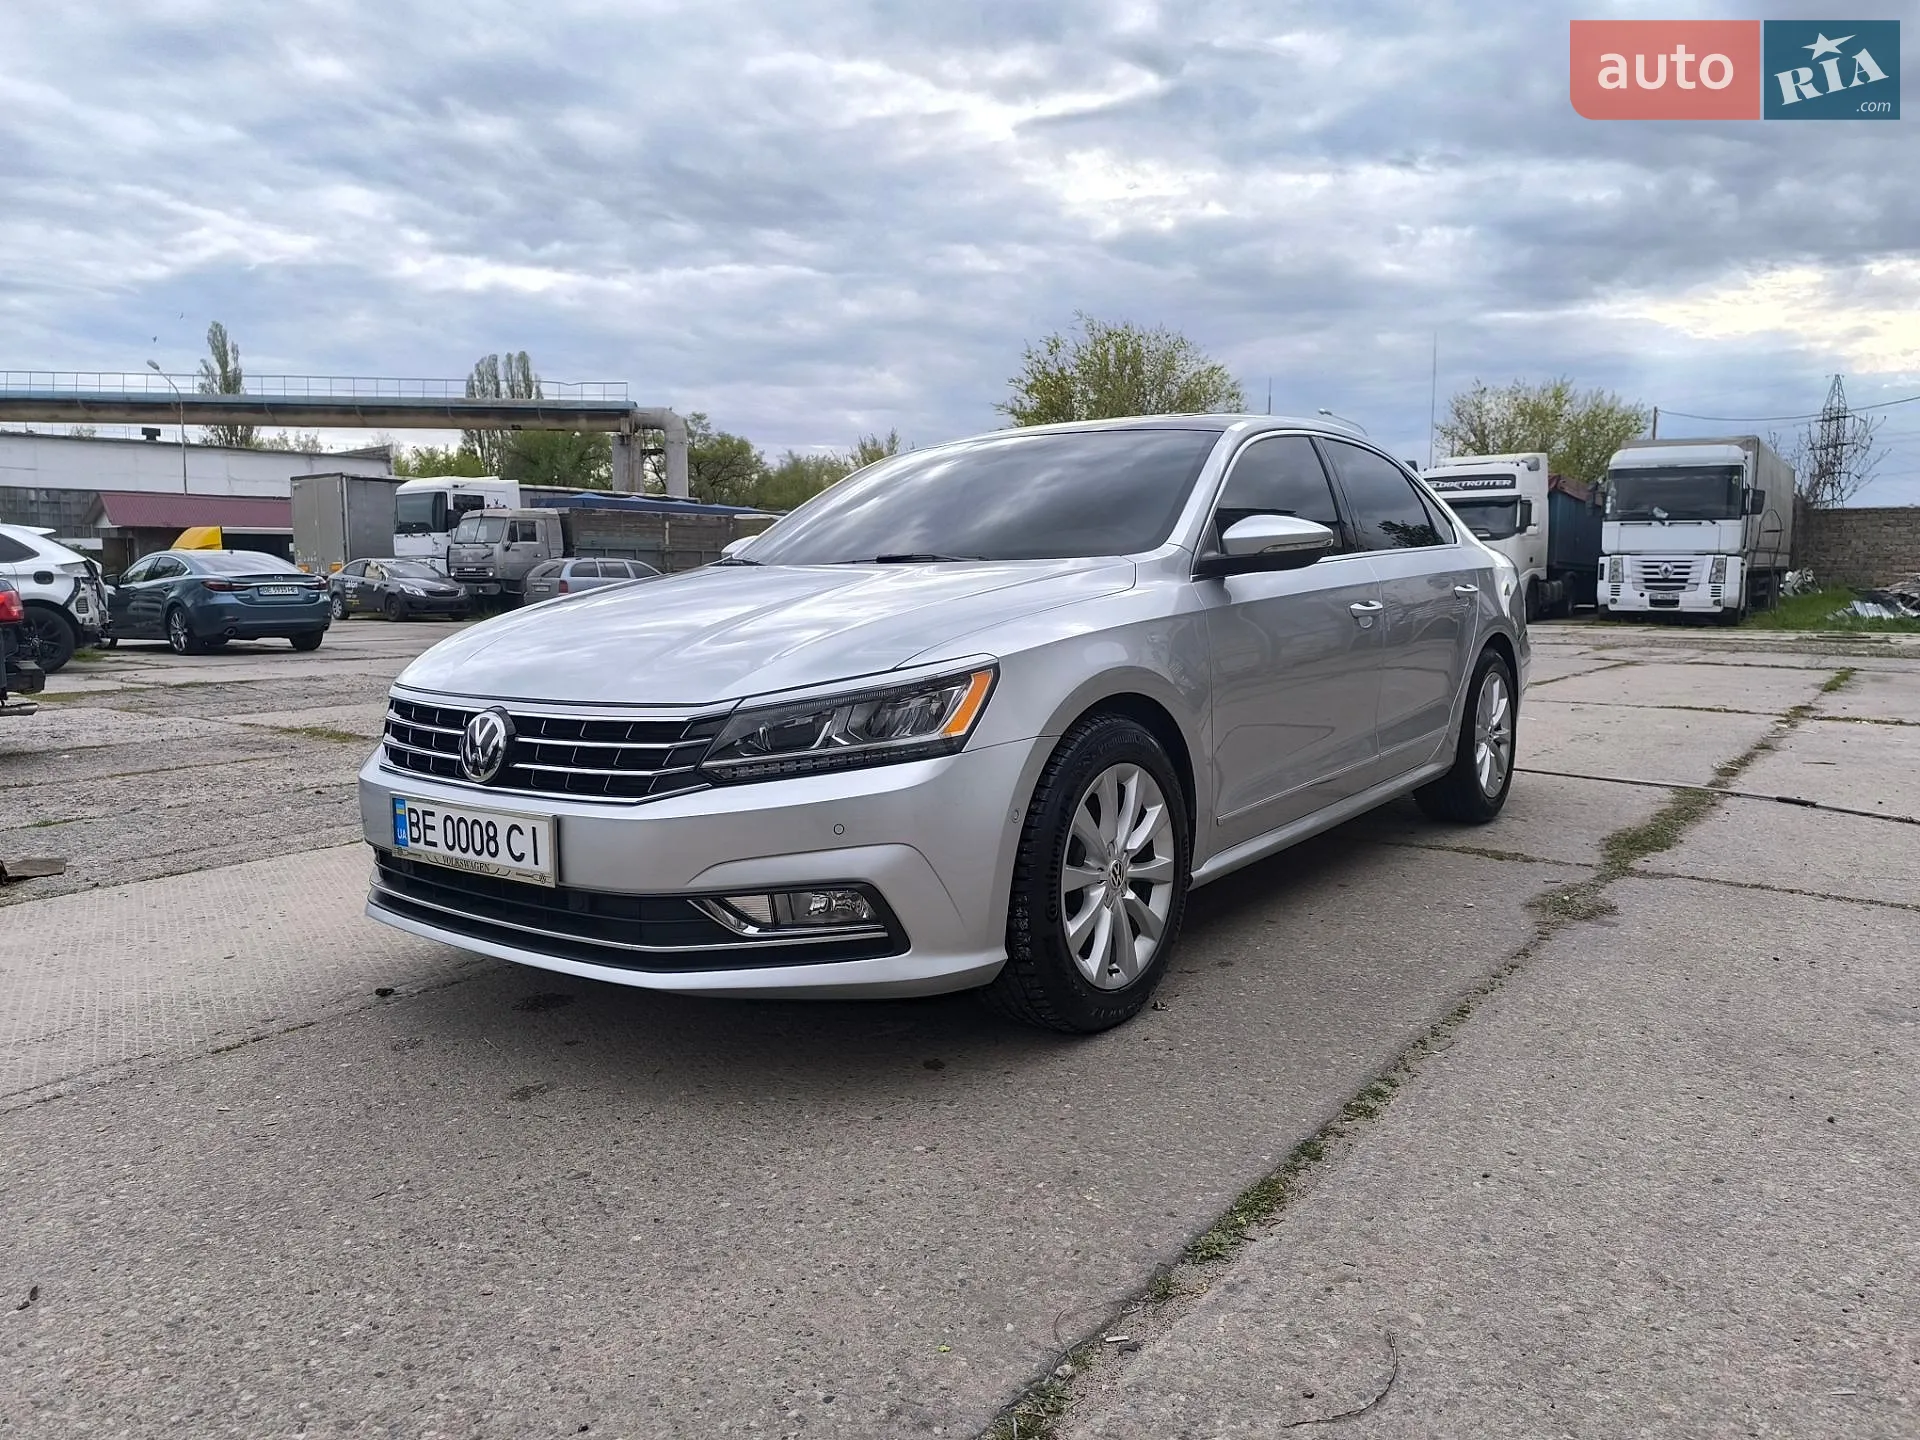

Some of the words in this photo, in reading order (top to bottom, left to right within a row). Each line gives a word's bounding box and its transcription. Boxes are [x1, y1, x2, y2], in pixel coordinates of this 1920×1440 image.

[397, 828, 408, 839] UA
[408, 807, 438, 848] BE
[443, 814, 500, 858] 0008
[506, 824, 539, 865] CI
[442, 855, 490, 873] VOLKSWAGEN
